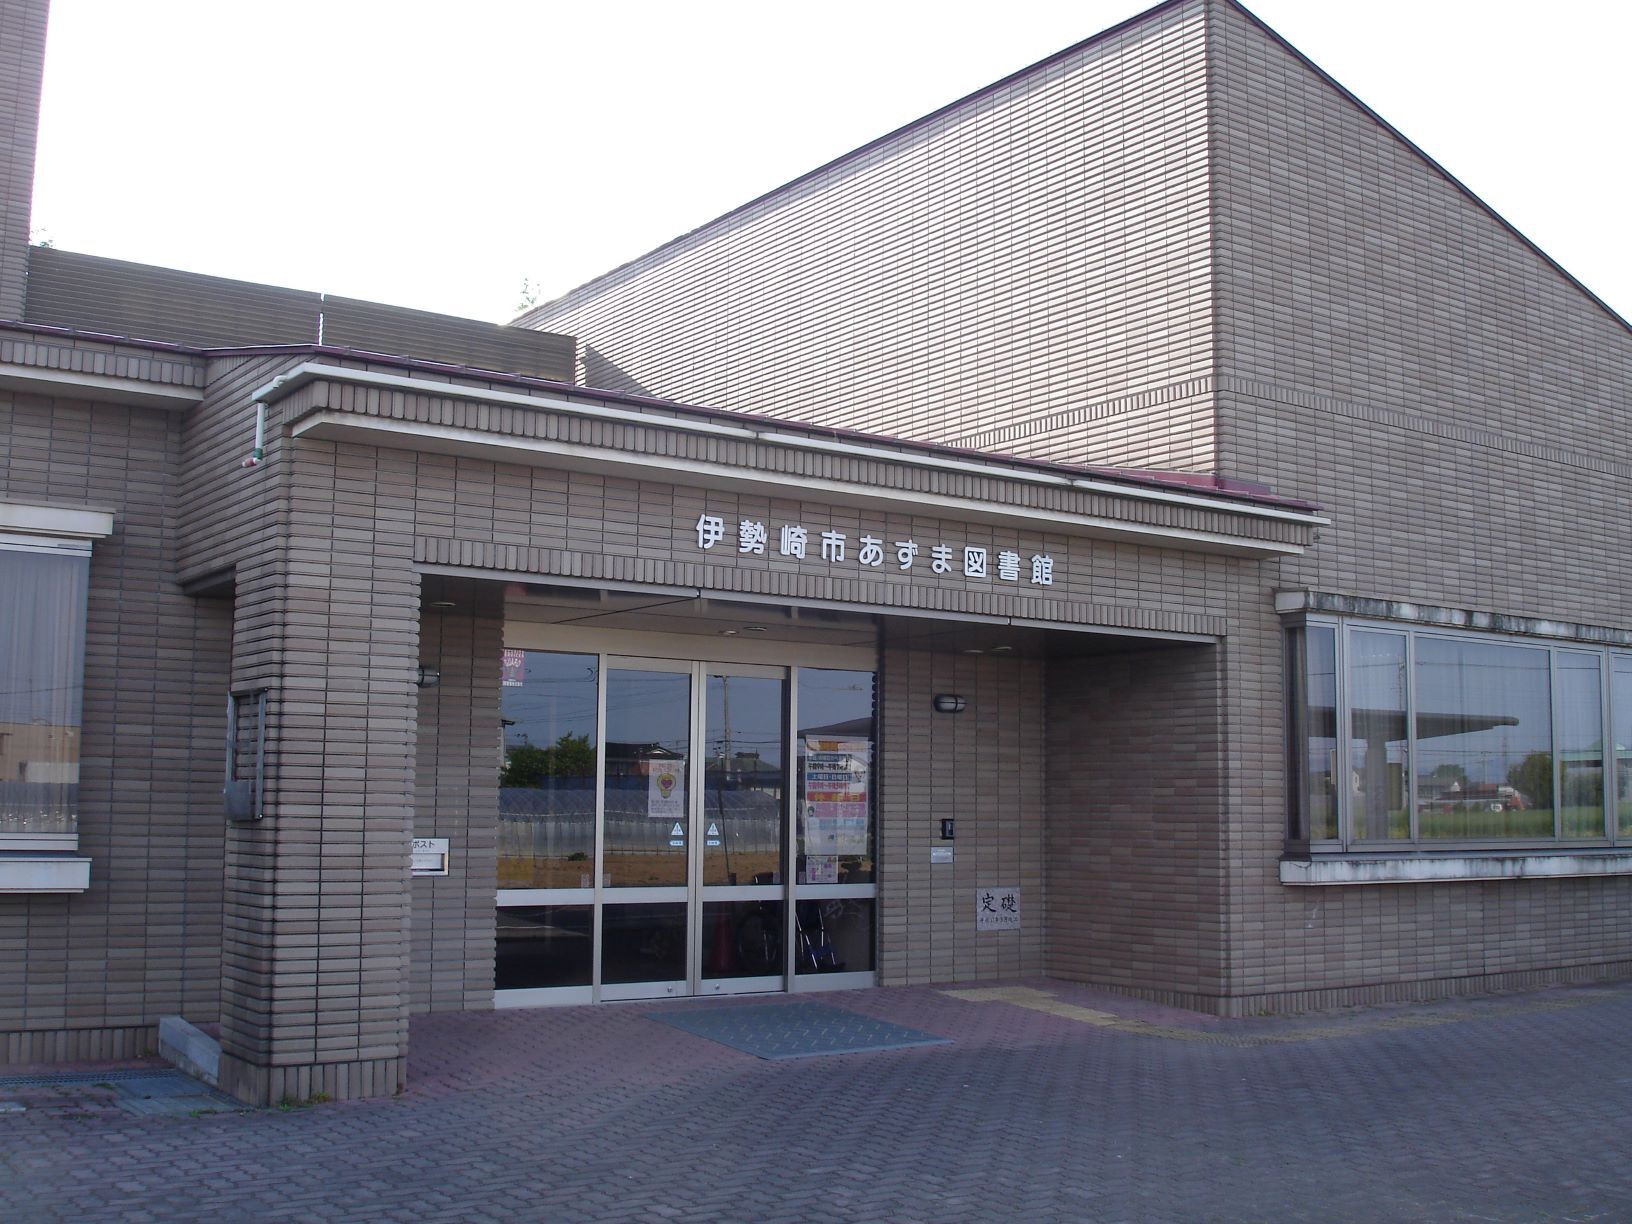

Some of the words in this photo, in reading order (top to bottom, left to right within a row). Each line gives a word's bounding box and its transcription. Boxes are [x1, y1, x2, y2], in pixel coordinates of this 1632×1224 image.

[696, 513, 1054, 586] 伊勢崎市あずま図書館
[981, 892, 1017, 912] 定礎
